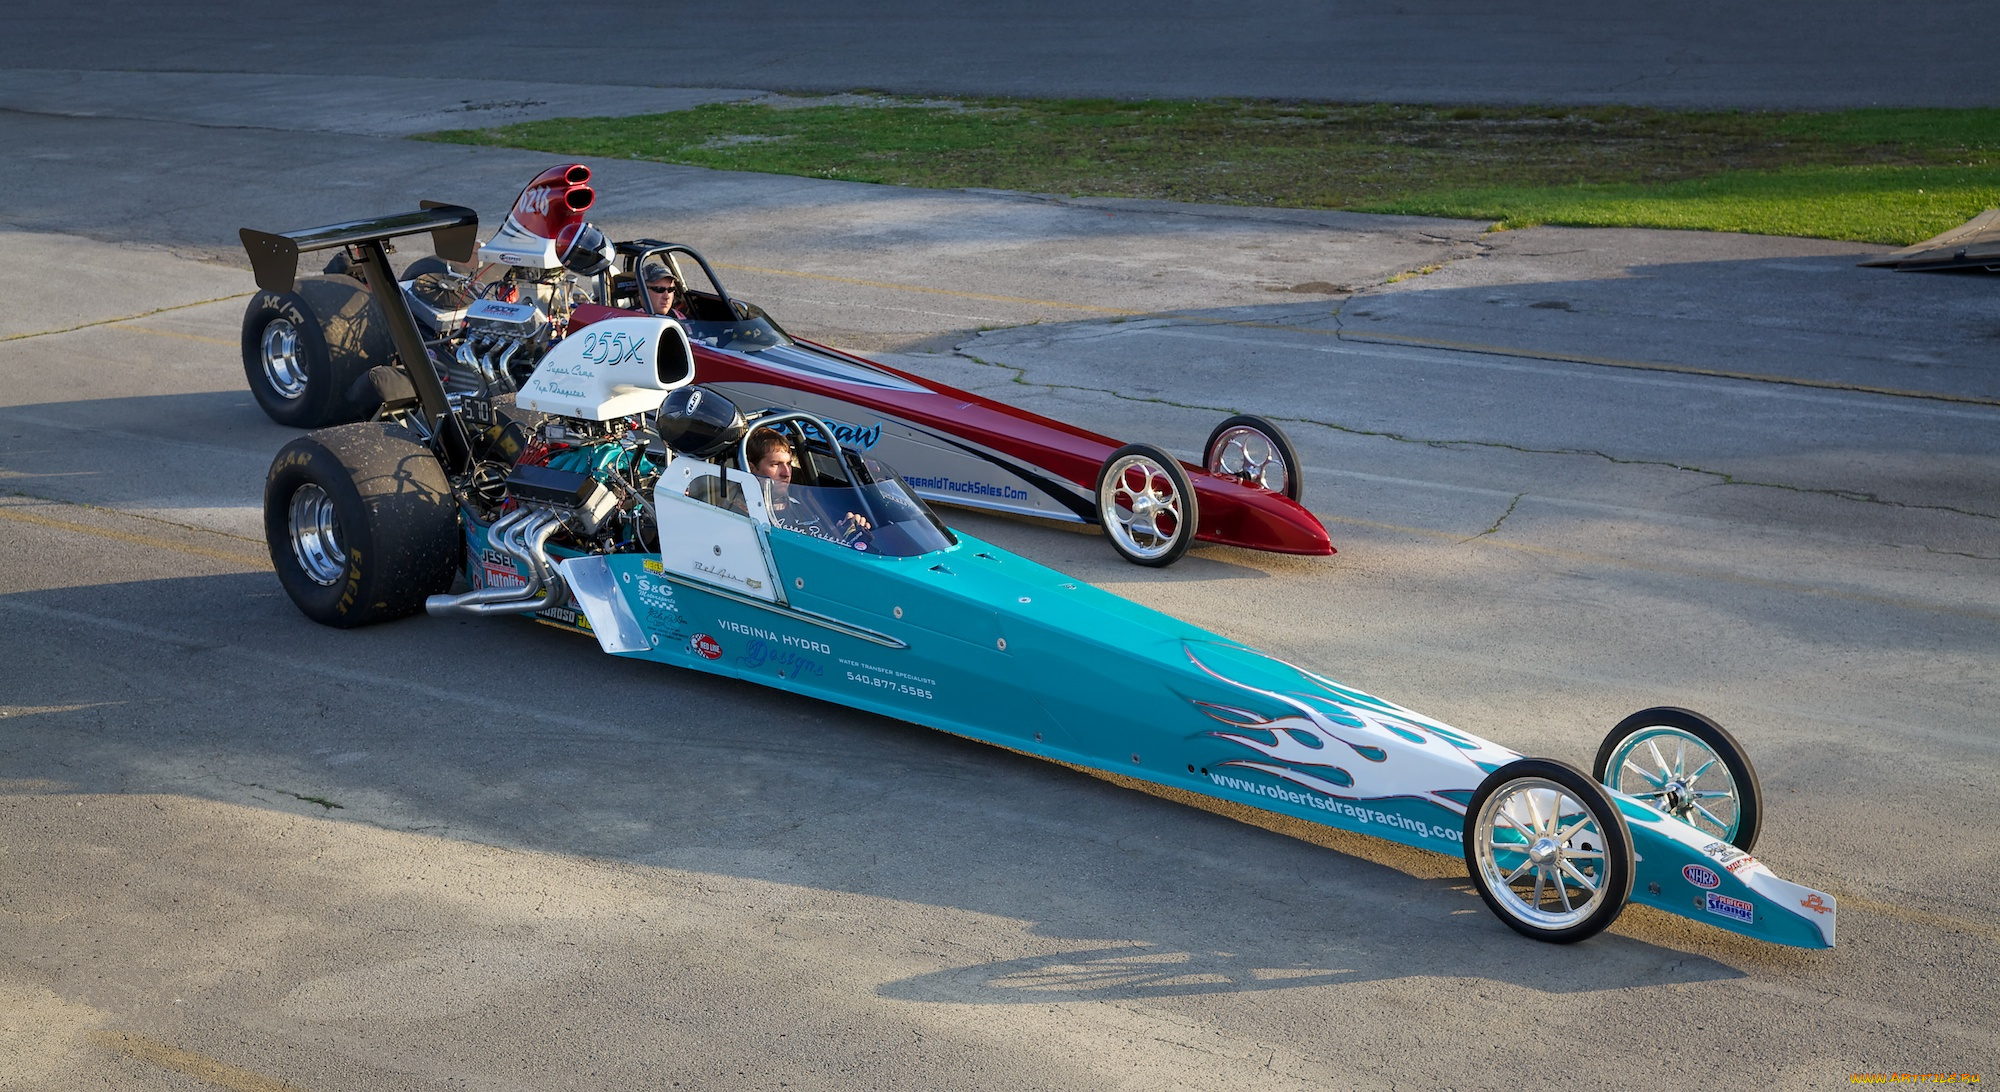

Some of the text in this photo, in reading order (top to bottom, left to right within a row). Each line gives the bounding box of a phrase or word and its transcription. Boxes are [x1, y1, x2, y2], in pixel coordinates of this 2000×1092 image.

[262, 295, 304, 324] M/T
[582, 332, 646, 366] 255X
[464, 399, 489, 421] 5.70
[718, 619, 831, 655] VIRGINIA HYDRO
[839, 658, 936, 686] WATER TRANSFER SPECIALISTS
[847, 671, 933, 699] 540.877.5585
[1688, 869, 1715, 885] NHRA
[1708, 899, 1752, 918] Strange
